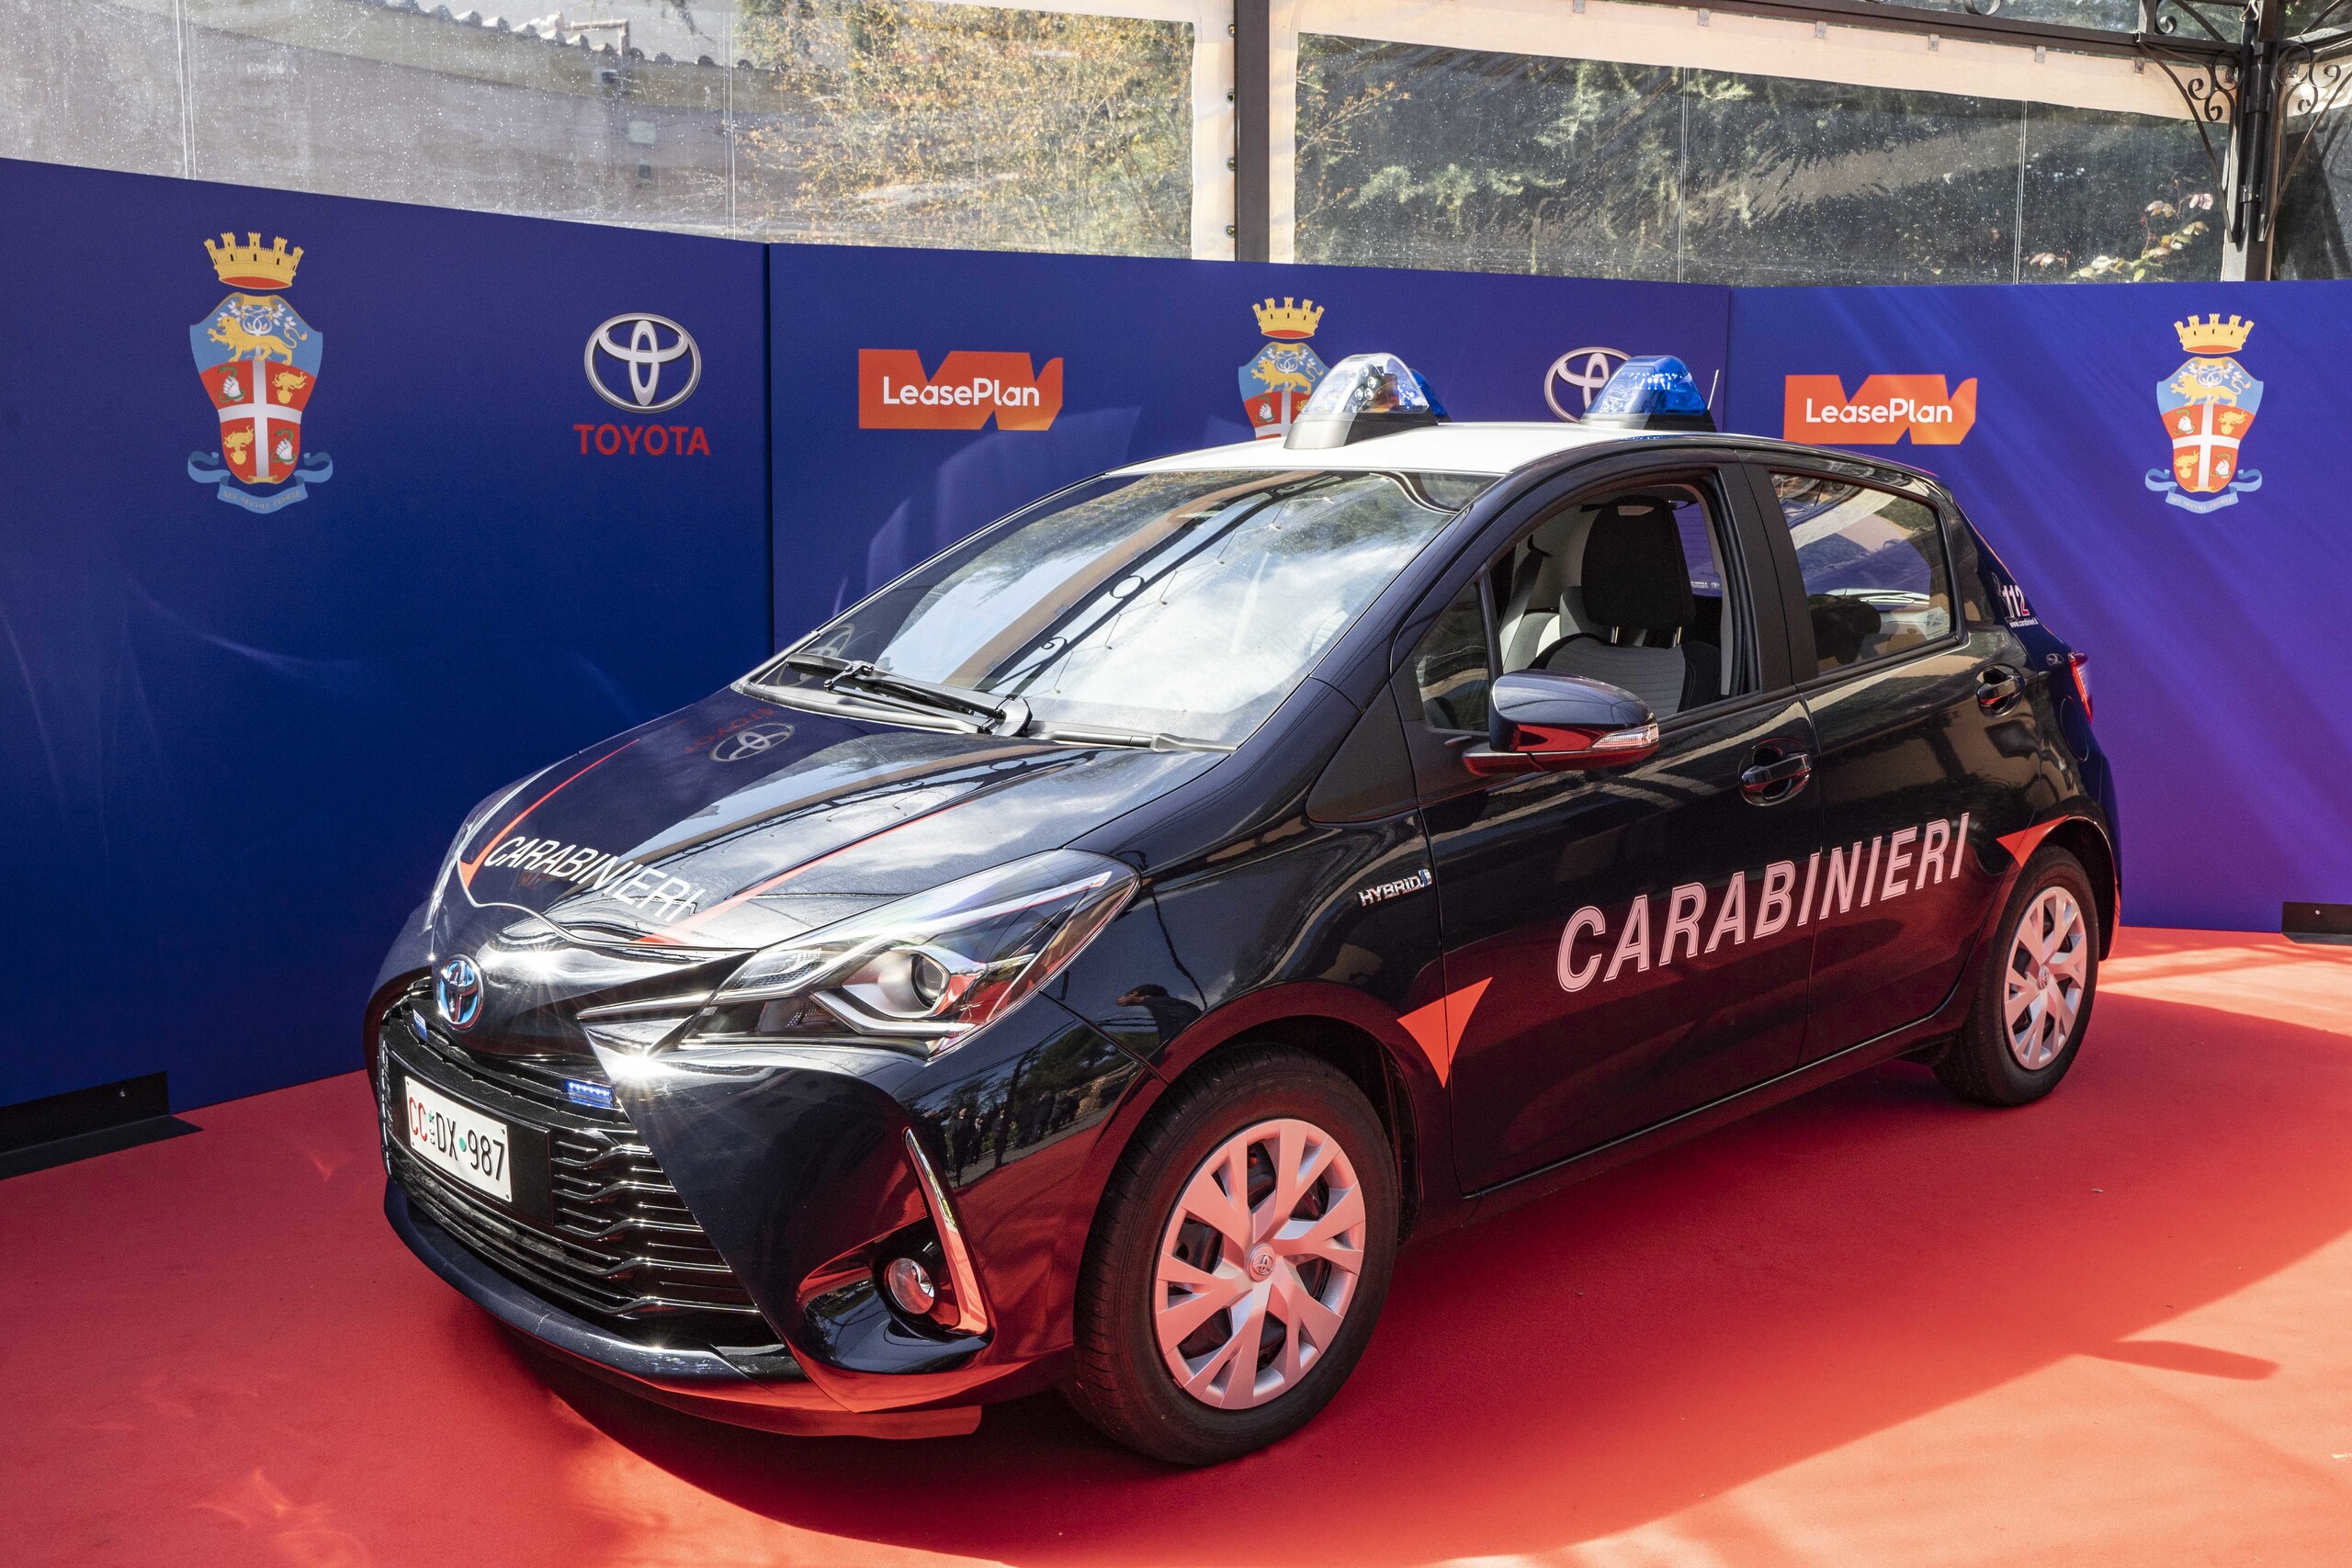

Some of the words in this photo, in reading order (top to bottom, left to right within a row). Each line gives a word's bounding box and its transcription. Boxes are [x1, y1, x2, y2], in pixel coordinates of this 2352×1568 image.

[883, 376, 1040, 407] LeasePlan
[1805, 398, 1953, 423] LeasePlan
[573, 423, 711, 457] TOYOTA
[2002, 584, 2030, 618] 112
[483, 836, 707, 923] CARABINIERI
[1358, 875, 1422, 908] HYBRID
[1556, 812, 1970, 993] CARABINIERI
[409, 1096, 428, 1143] CC
[435, 1111, 459, 1162] DX
[467, 1129, 506, 1182] 987
